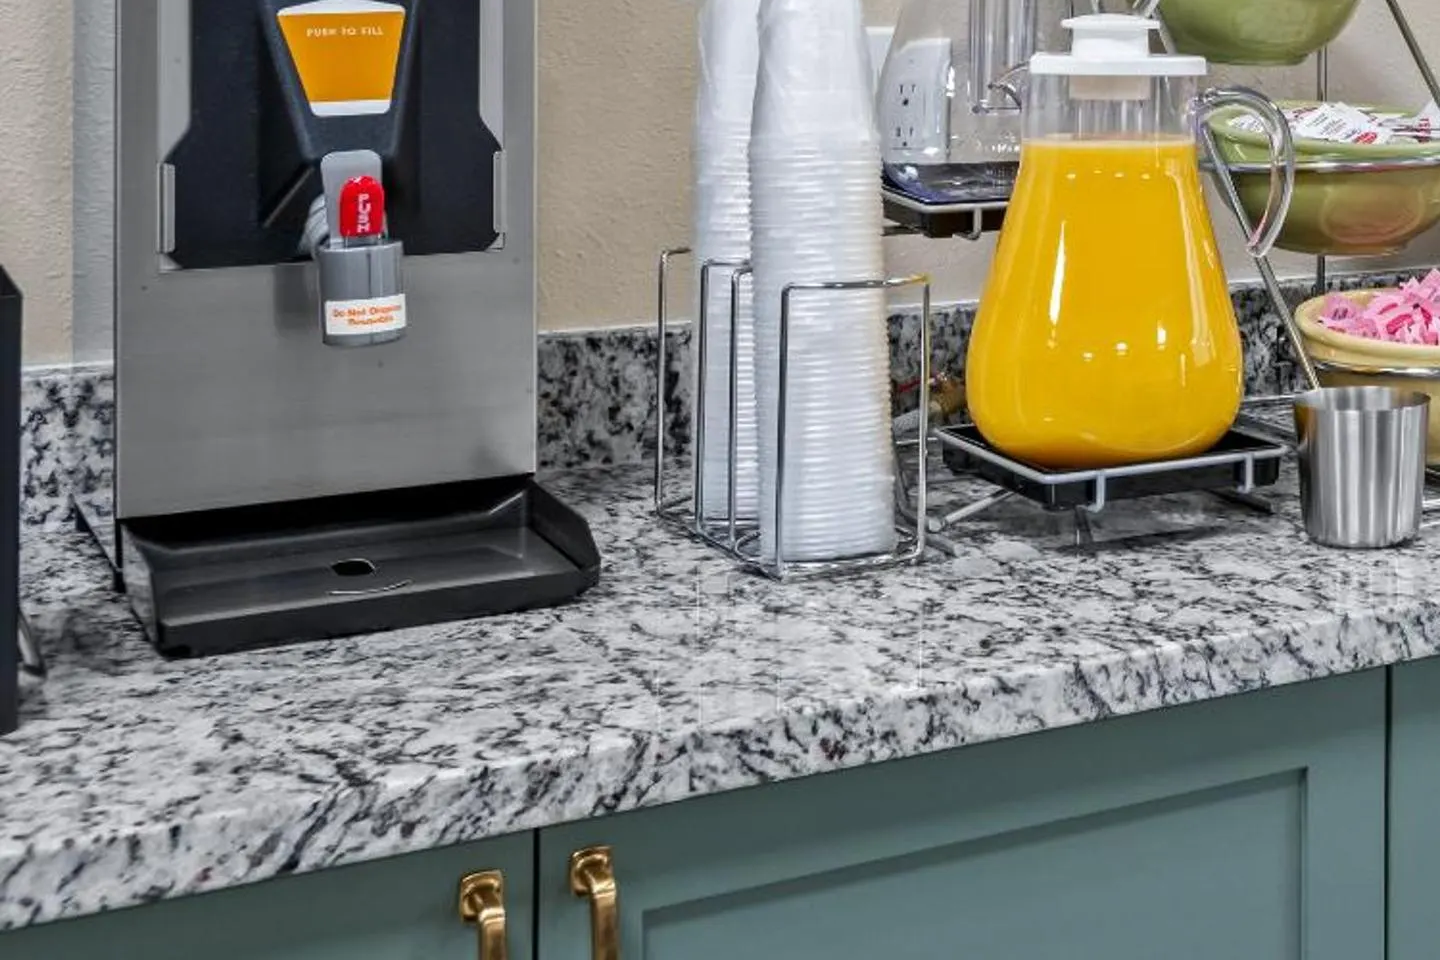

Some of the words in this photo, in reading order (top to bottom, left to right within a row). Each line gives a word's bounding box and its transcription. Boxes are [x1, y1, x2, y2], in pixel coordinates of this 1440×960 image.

[306, 26, 338, 38] PUSH
[341, 26, 357, 37] TO
[361, 25, 384, 37] FILL
[357, 193, 372, 234] PUSH
